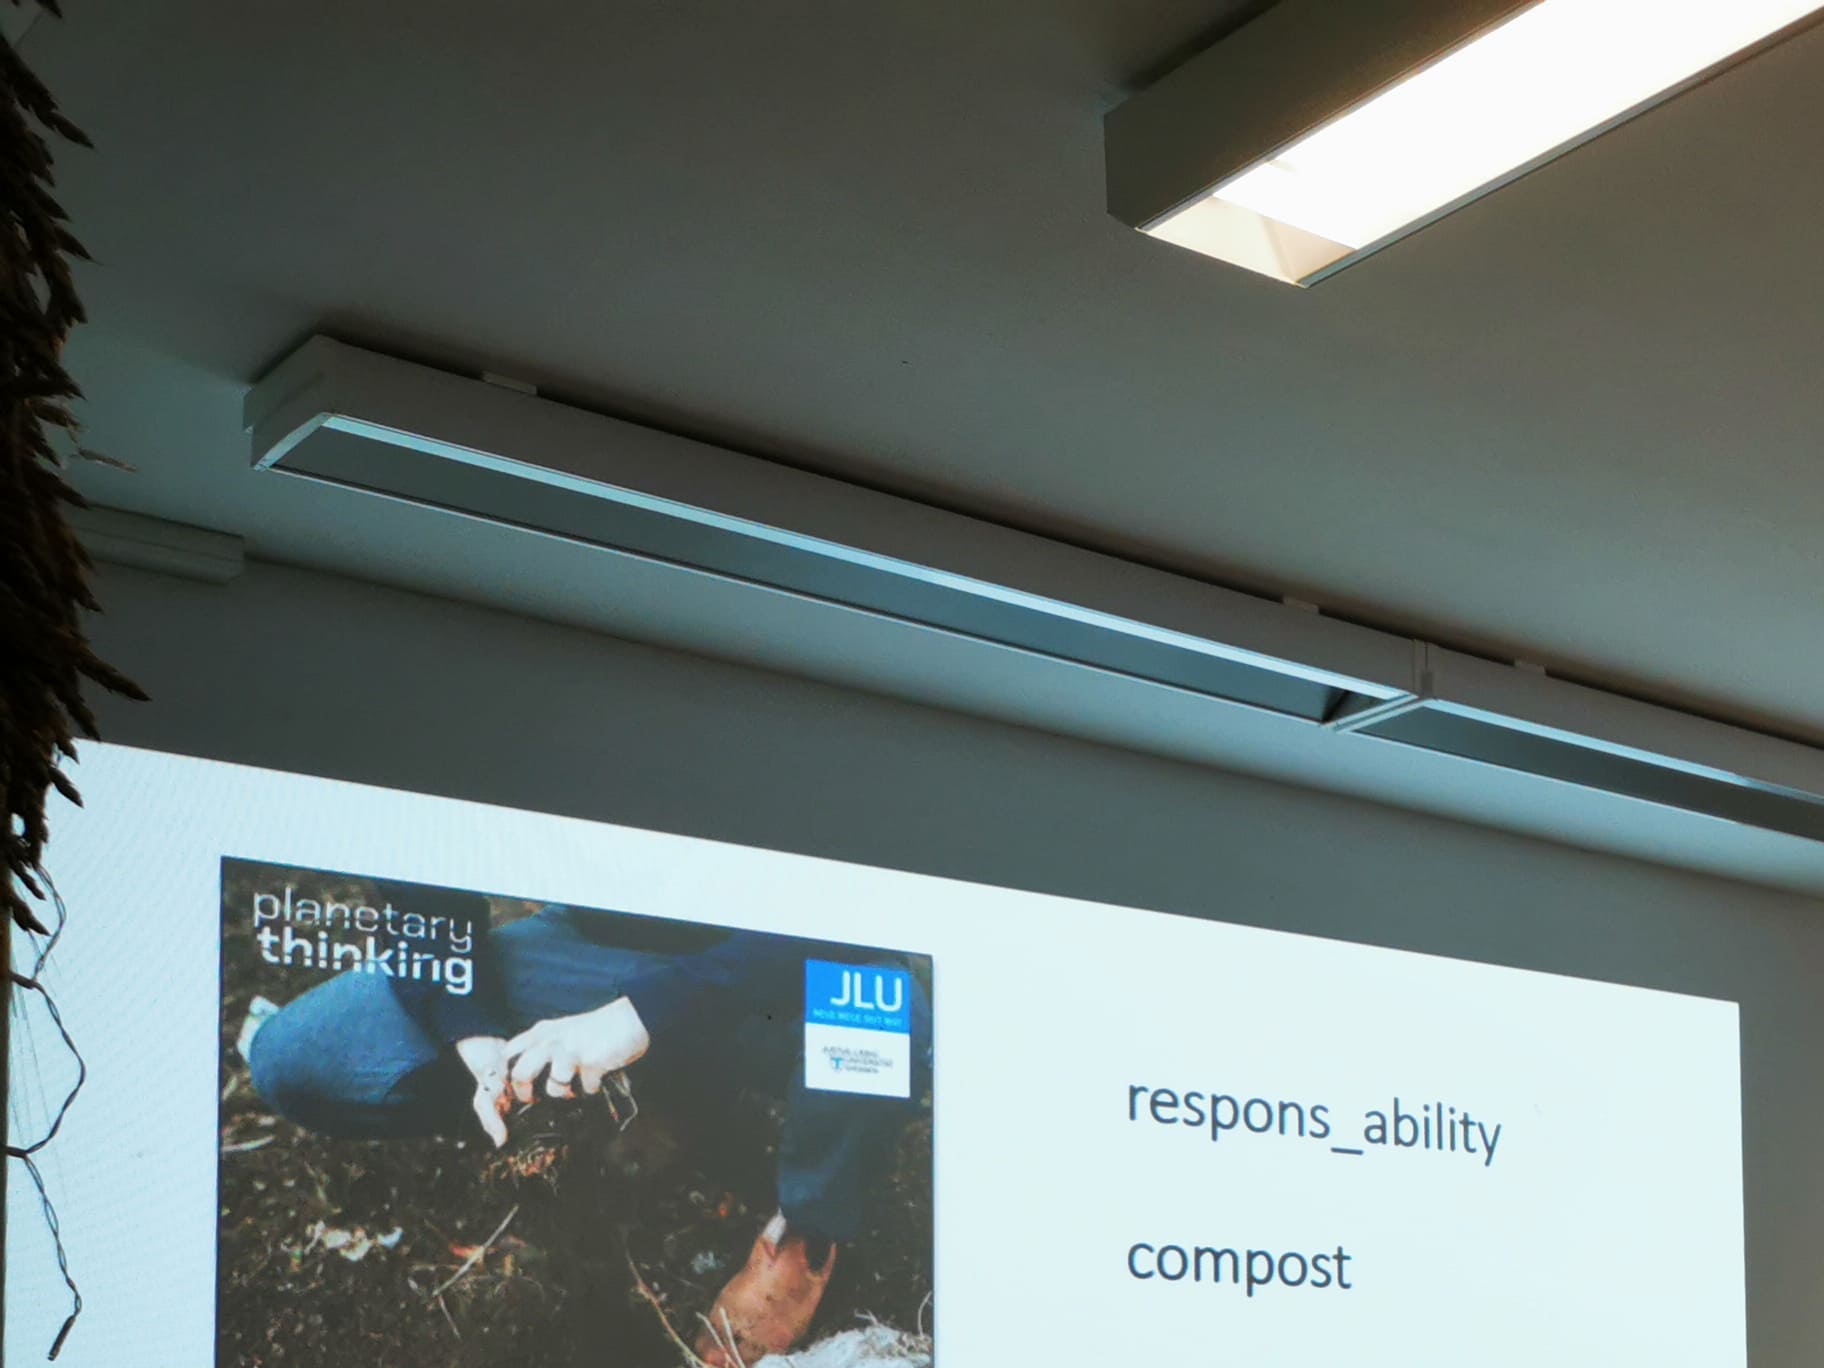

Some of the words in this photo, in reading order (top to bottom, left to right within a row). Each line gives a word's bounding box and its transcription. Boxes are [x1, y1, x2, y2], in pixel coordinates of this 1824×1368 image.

[253, 886, 473, 954] planetary
[256, 926, 474, 995] thinking
[830, 970, 903, 1012] JLU
[1128, 1084, 1502, 1167] respons_ability
[1127, 1243, 1352, 1298] compost
